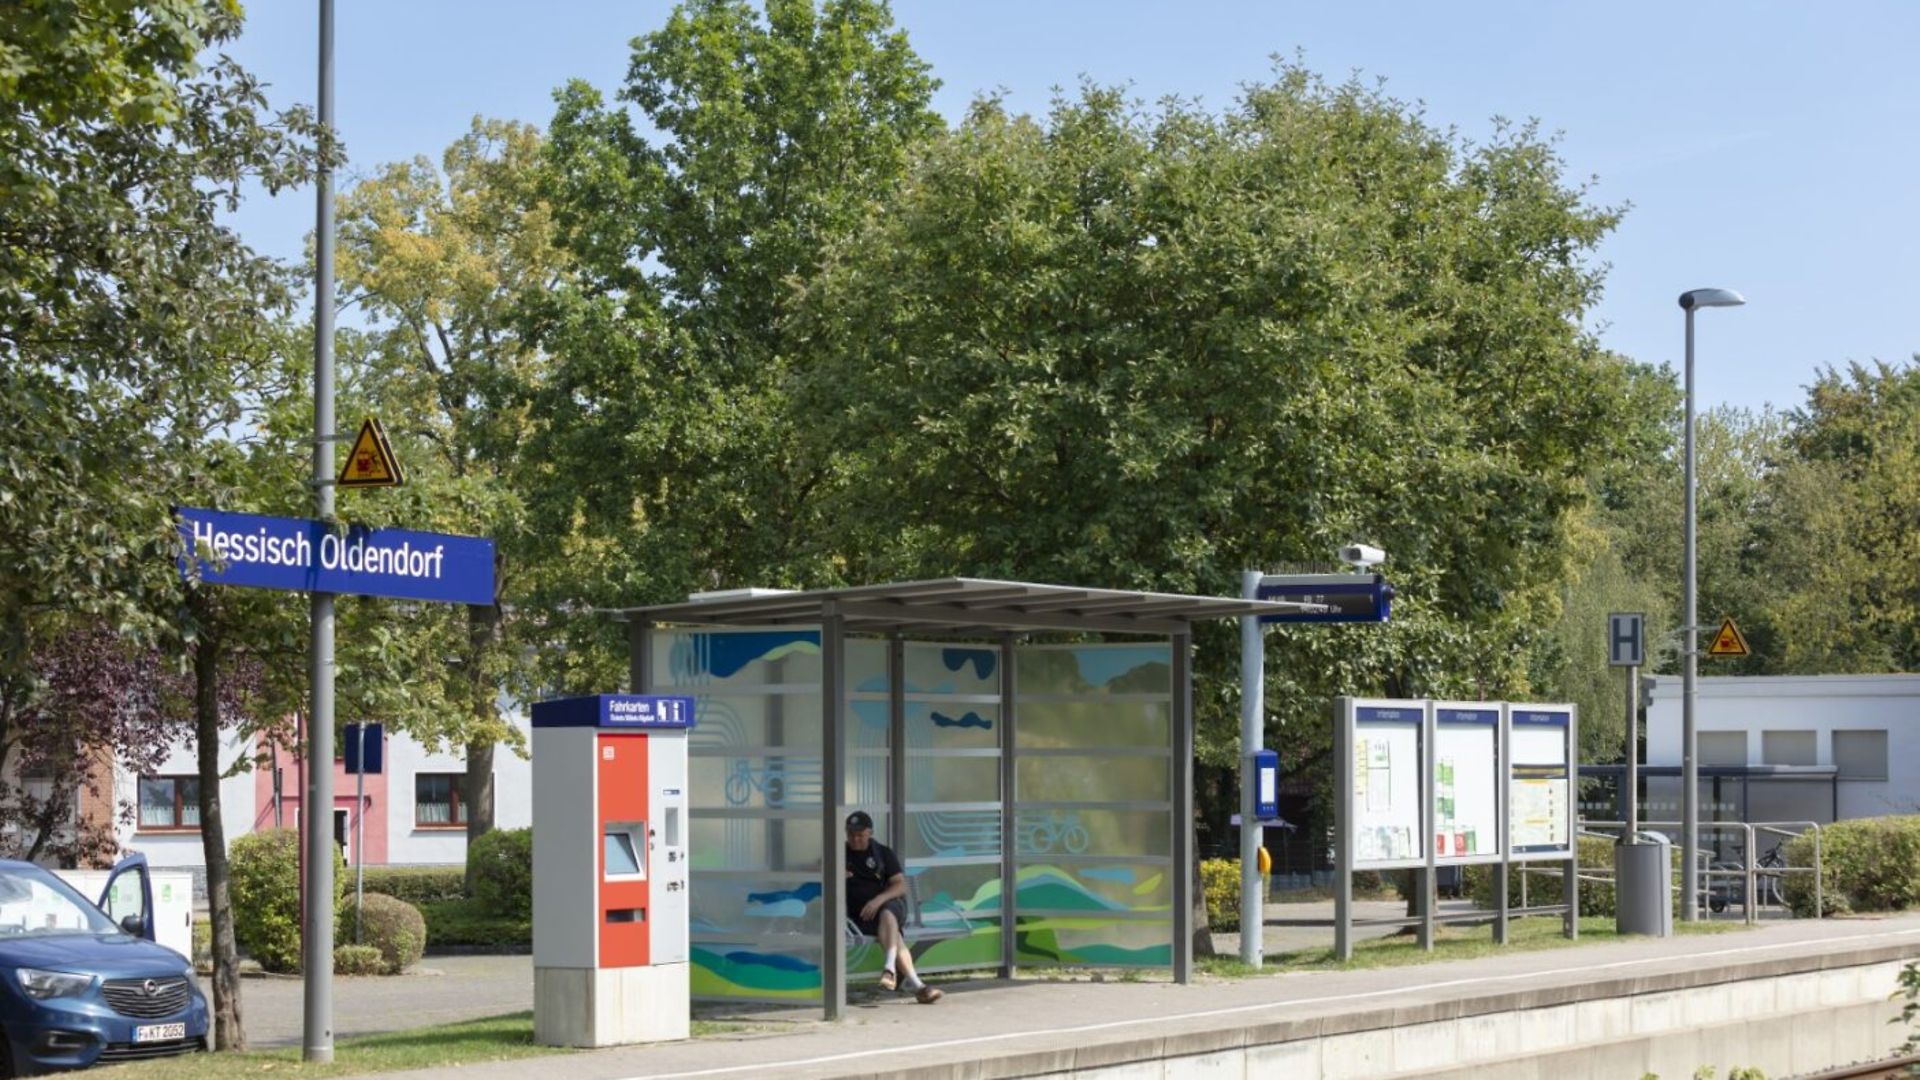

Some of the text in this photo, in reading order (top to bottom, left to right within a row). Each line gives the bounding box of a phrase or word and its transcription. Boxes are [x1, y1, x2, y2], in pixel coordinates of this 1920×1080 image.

[193, 521, 444, 579] Hessisch Oldendorf
[1612, 617, 1639, 661] H
[609, 700, 650, 713] Fahrkarten
